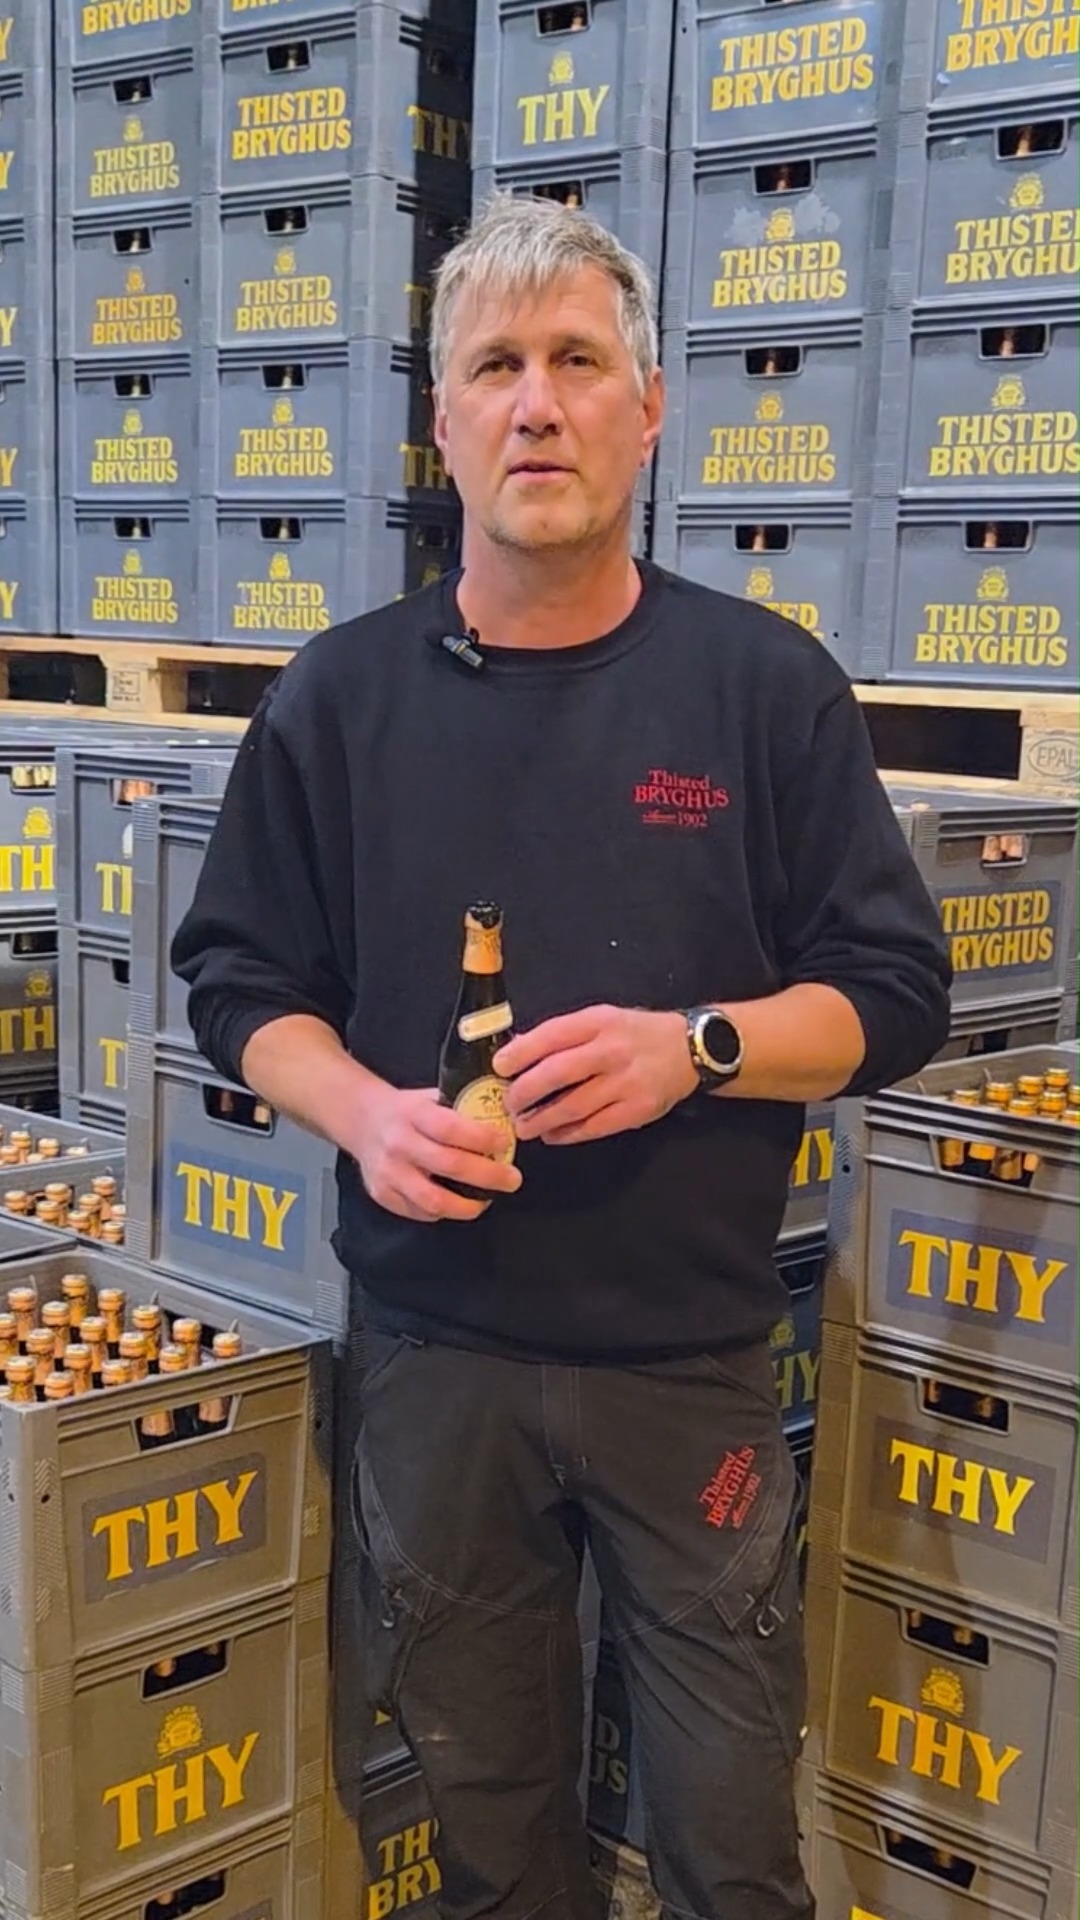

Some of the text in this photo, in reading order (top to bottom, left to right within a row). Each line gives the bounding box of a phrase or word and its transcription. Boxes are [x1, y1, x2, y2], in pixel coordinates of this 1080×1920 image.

[720, 18, 867, 71] THISTED
[946, 15, 1080, 72] BRYGH
[711, 54, 873, 111] BRYGHUS
[238, 87, 346, 127] THISTED
[518, 85, 609, 145] THY
[232, 118, 352, 160] BRYGHUS
[407, 105, 470, 160] TH
[94, 141, 174, 173] THISTED
[90, 164, 180, 197] BRYGHUS
[955, 209, 1080, 252] THISTE
[719, 241, 841, 276] THISTED
[946, 242, 1080, 284] BRYGHU
[240, 275, 331, 306] THISTED
[712, 269, 847, 308] BRYGHUS
[96, 293, 177, 320] THISTED
[236, 300, 337, 331] BRYGHUS
[92, 316, 183, 346] BRYGHUS
[240, 427, 327, 453] THISTED
[710, 425, 830, 456] THISTED
[937, 412, 1078, 446] THISTED
[95, 437, 172, 461] THISTED
[235, 452, 333, 477] BRYGHUS
[399, 443, 448, 490] TH
[929, 442, 1080, 477] BRYGHUS
[91, 460, 178, 484] BRYGHUS
[702, 454, 836, 484] BRYGHUS
[95, 577, 172, 600] THISTED
[237, 581, 324, 607] THISTED
[92, 599, 178, 623] BRYGHUS
[233, 606, 330, 632] BRYGHUS
[923, 603, 1060, 635] THISTED
[915, 634, 1067, 667] BRYGHUS
[634, 785, 729, 808] BRYGHUS
[647, 769, 711, 790] Thisted
[678, 812, 708, 828] 1902
[0, 845, 55, 892] TH
[941, 889, 1050, 933] THISTED
[951, 926, 1054, 973] RYGHUS
[0, 1006, 56, 1055] TH
[176, 1161, 299, 1252] THY
[898, 1230, 1069, 1324] THY
[706, 1446, 755, 1528] BRYGHUS
[890, 1438, 1036, 1535] THY
[91, 1470, 257, 1581] THY
[868, 1696, 1022, 1805] THY
[103, 1732, 260, 1851] THY
